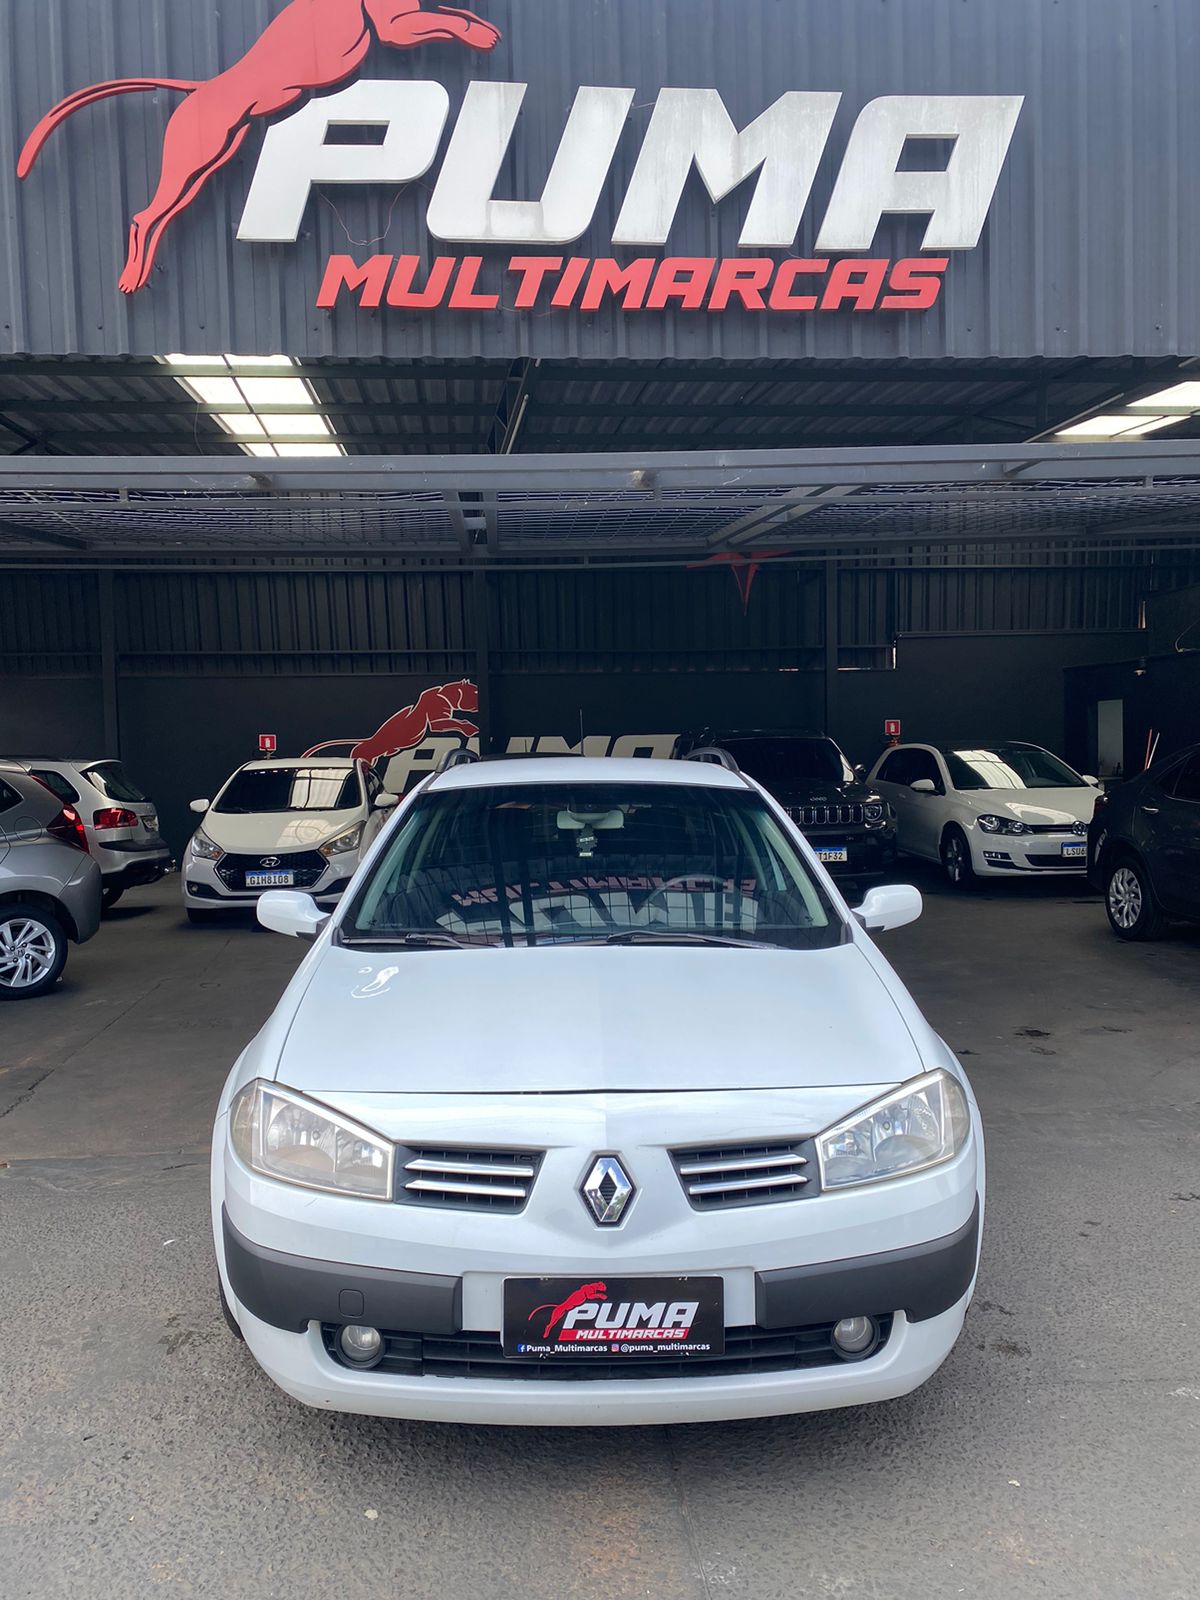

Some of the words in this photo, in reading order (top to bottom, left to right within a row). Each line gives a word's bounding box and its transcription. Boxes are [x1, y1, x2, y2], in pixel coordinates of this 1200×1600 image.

[236, 79, 1025, 252] PUMA
[315, 254, 950, 313] MULTIMARCAS
[1066, 848, 1085, 856] LSU6
[562, 1301, 700, 1329] PUMA
[575, 1328, 686, 1340] MULTIMARCAS
[526, 1344, 608, 1354] Puma_Multimarcas
[620, 1342, 711, 1354] @puma_multimarcas
